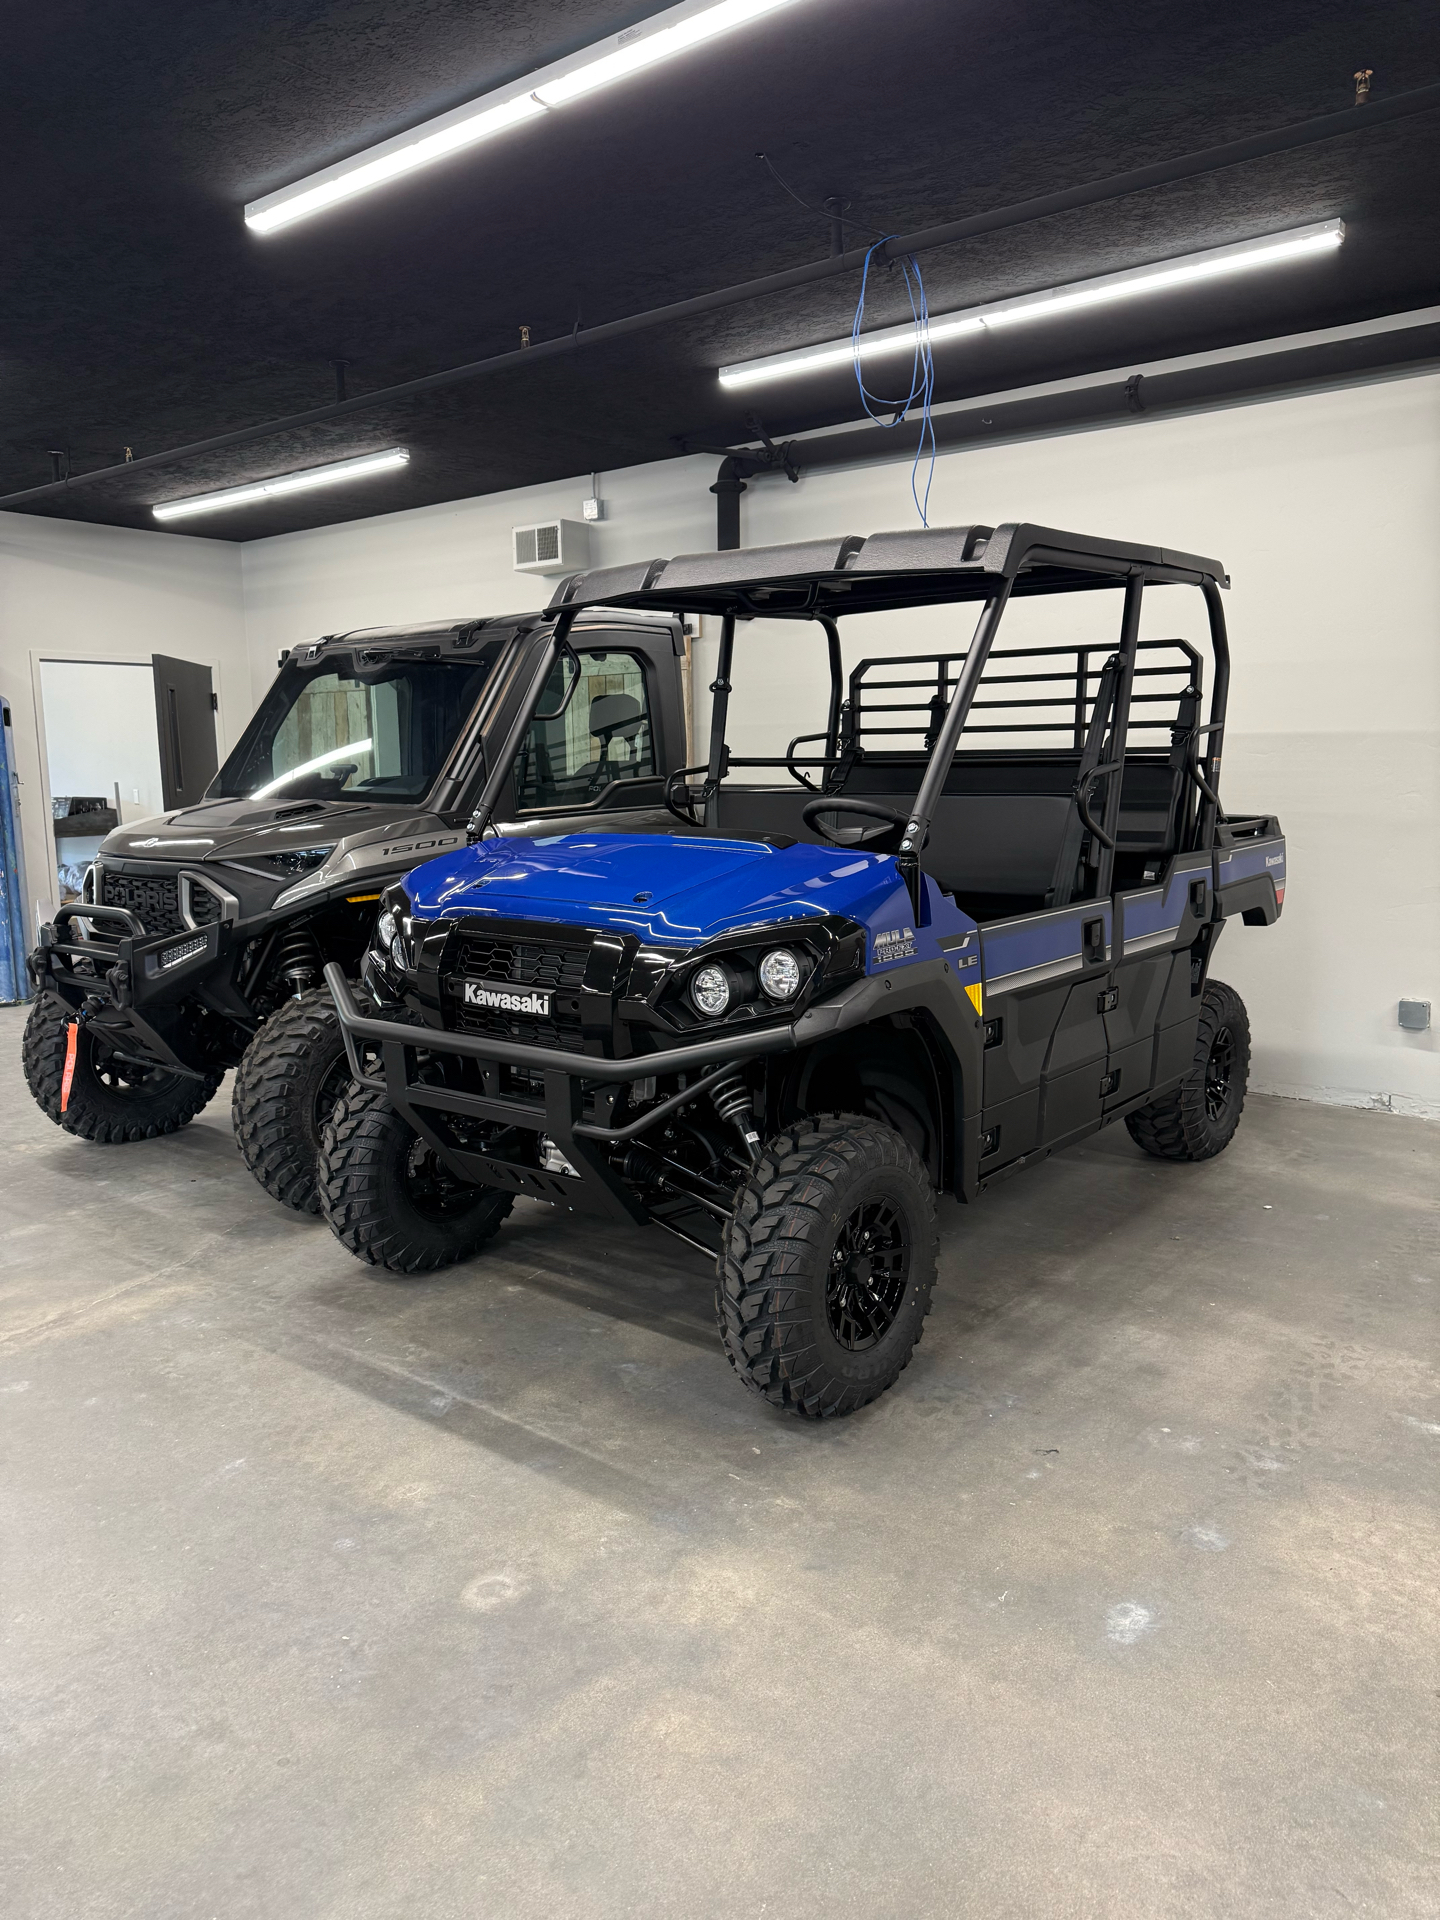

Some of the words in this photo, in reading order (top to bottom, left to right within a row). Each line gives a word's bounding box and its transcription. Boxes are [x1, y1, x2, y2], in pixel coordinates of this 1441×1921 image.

[382, 837, 458, 856] 1500
[1265, 852, 1284, 868] Kawasaki
[104, 885, 178, 911] POLARIS
[958, 954, 978, 970] LE
[464, 982, 549, 1016] Kawasaki
